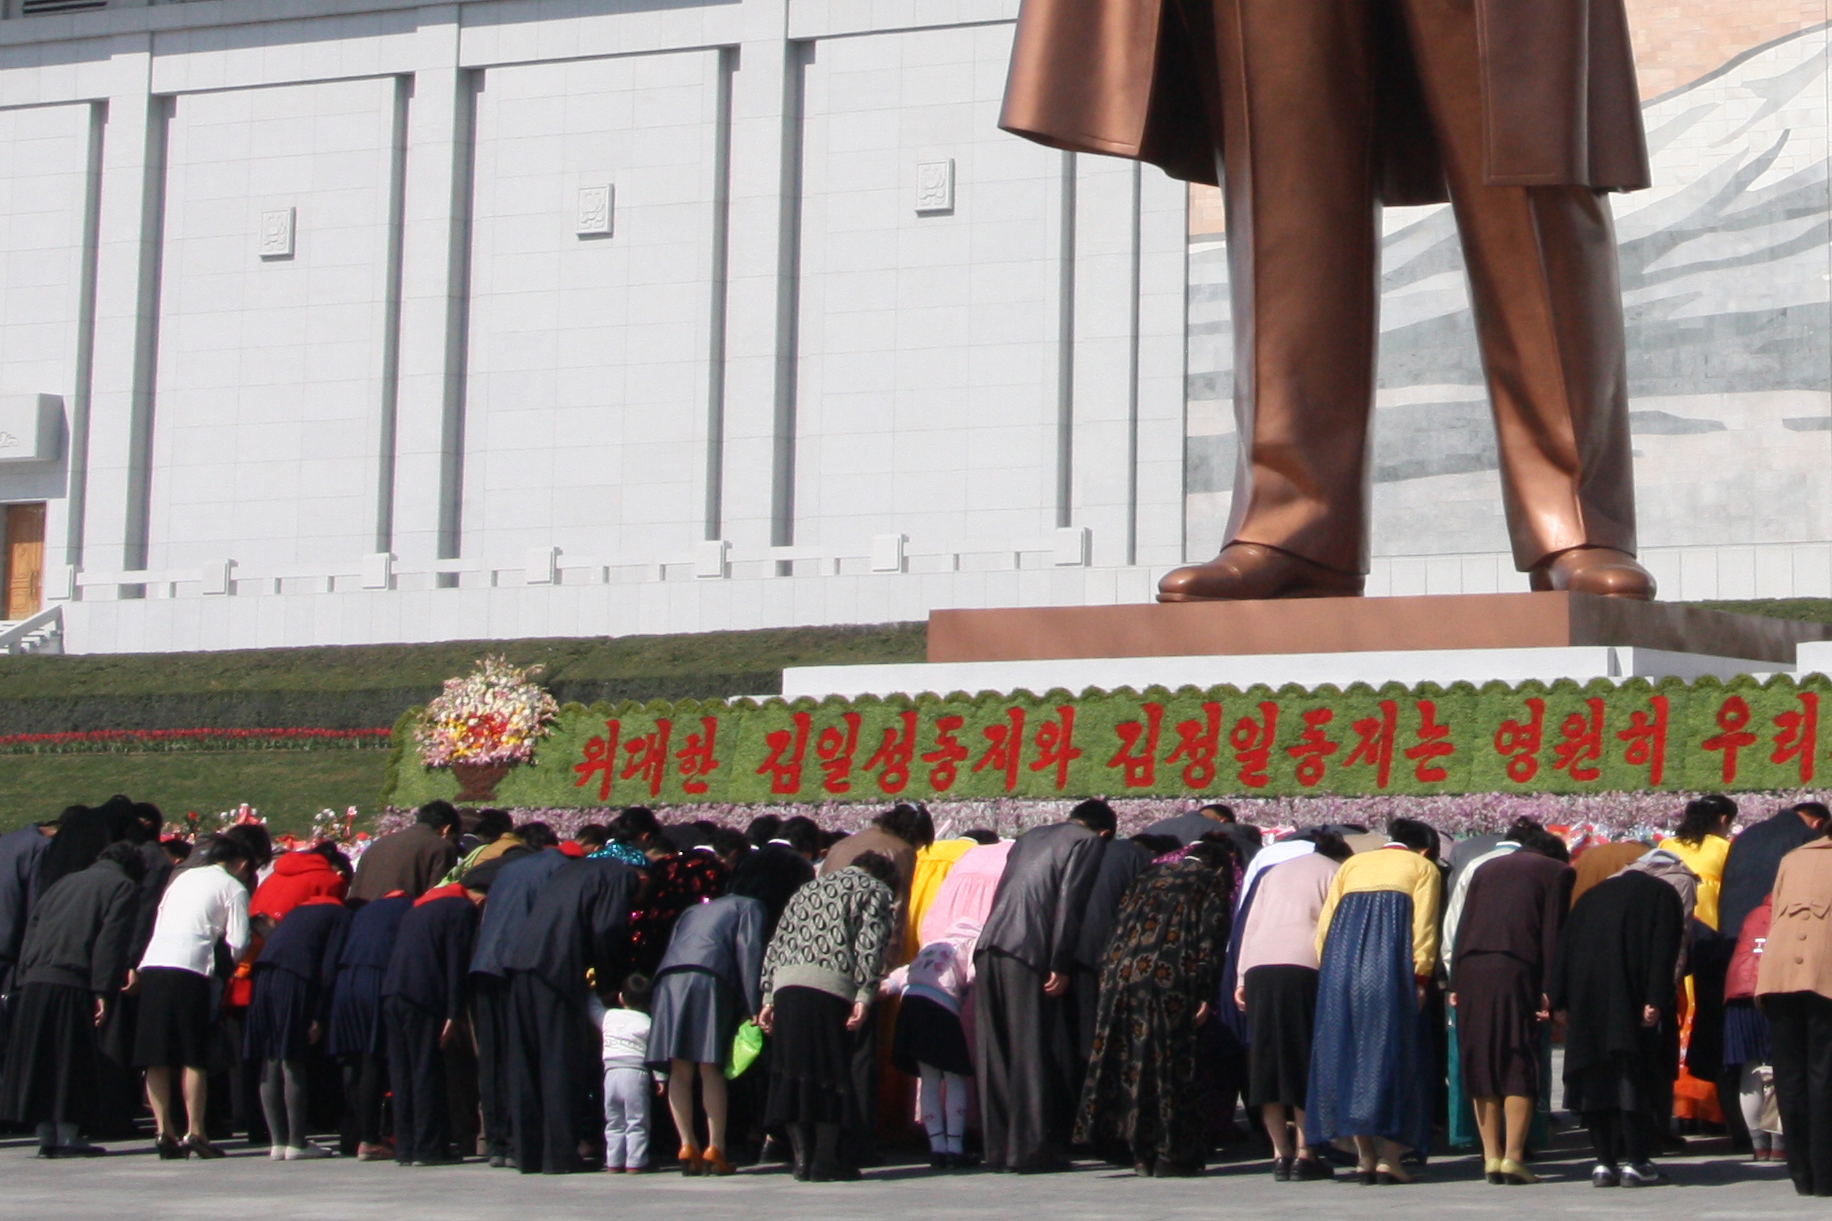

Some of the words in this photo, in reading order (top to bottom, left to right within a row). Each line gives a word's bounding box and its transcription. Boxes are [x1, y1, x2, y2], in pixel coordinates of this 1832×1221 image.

[574, 715, 720, 801] 위대한
[756, 705, 1082, 794] 김일성동지와
[1107, 699, 1455, 789] 김정일동지는
[1495, 695, 1669, 786] 영원히
